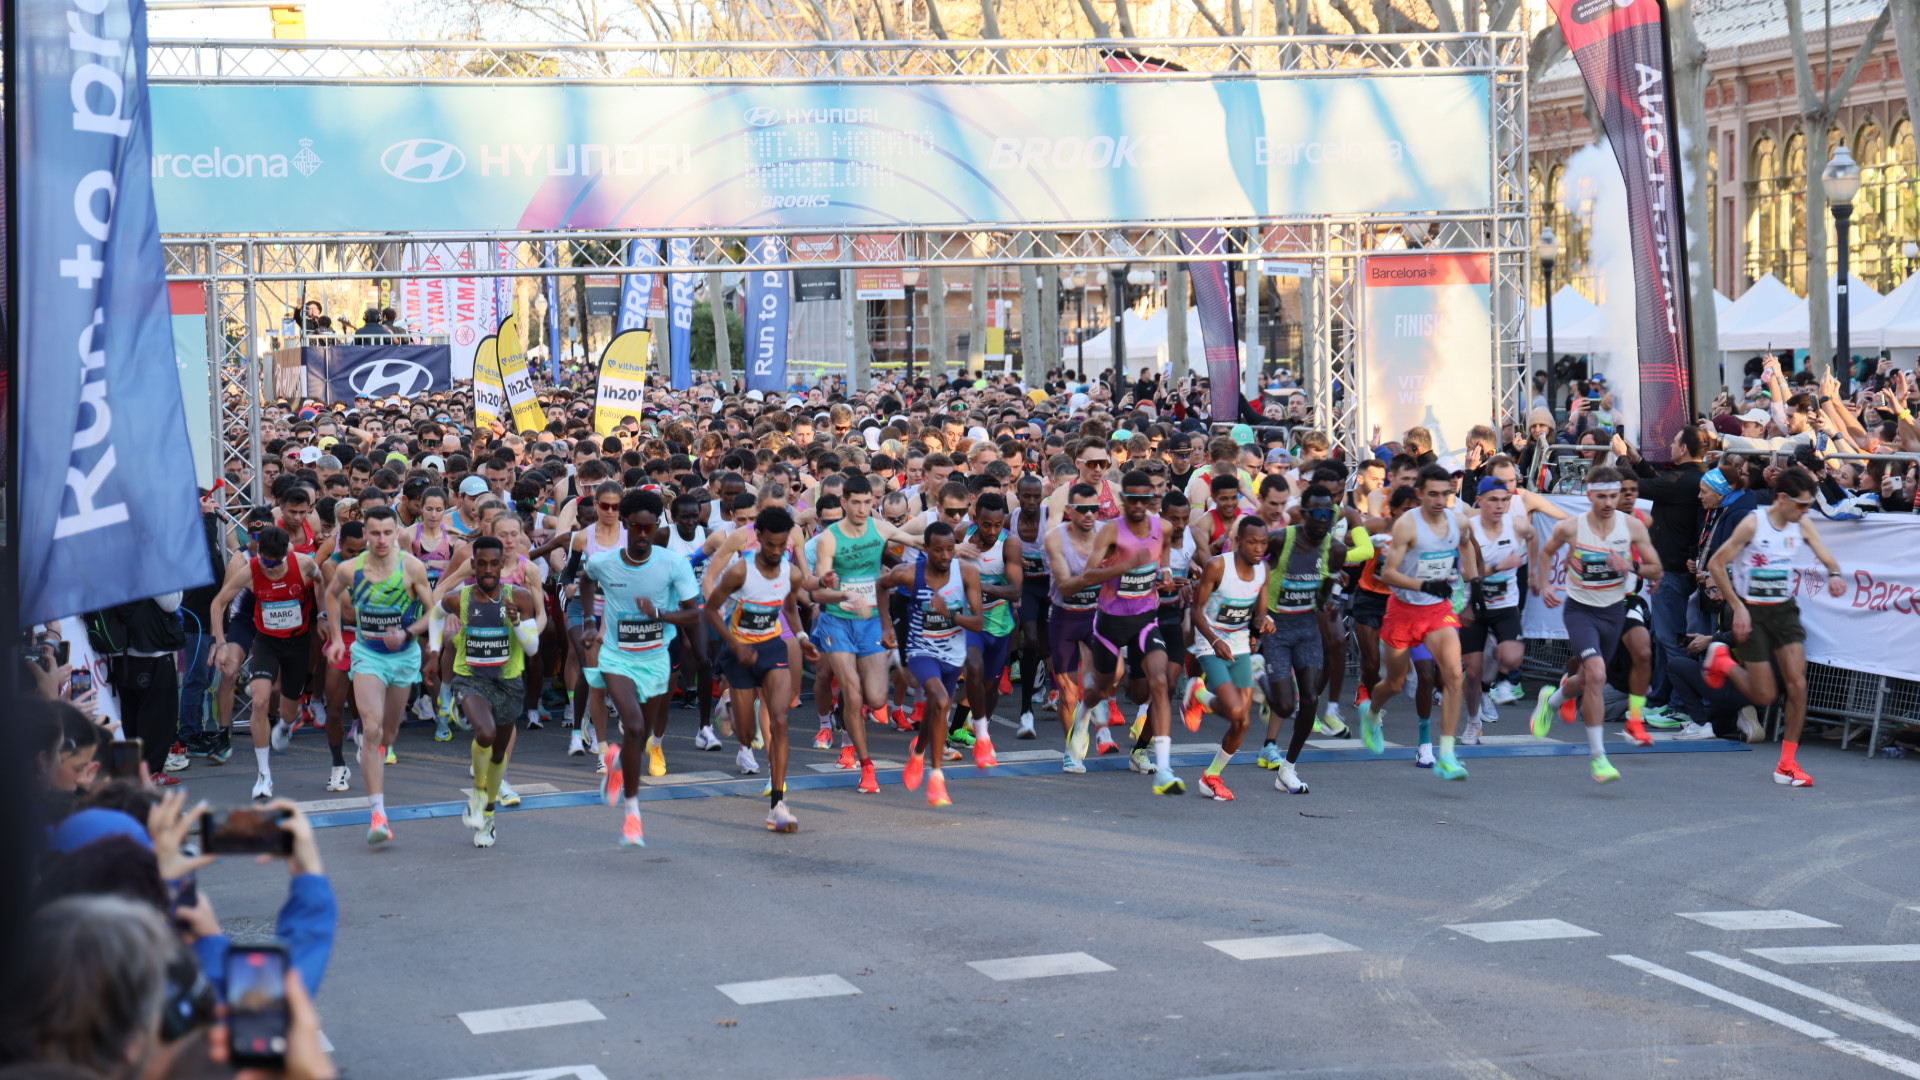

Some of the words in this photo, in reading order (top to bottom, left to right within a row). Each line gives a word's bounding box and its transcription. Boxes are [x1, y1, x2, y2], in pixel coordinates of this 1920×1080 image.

[786, 108, 878, 123] HYUNDAI
[744, 131, 820, 158] MITJA
[832, 124, 935, 157] MARATÓ
[1255, 136, 1402, 165] Barcelona
[152, 147, 288, 178] rcelona
[480, 143, 692, 177] HYUNDAI
[989, 136, 1167, 170] BROOKS
[745, 161, 896, 188] BARCELONA
[761, 195, 830, 208] BROOKS
[1372, 267, 1427, 279] Barcelona
[759, 293, 778, 321] to
[755, 327, 776, 376] Run
[484, 368, 500, 377] vitha
[618, 363, 644, 372] vithas
[270, 610, 293, 619] MARC
[618, 622, 663, 634] MOHAMED
[466, 640, 509, 648] CHIAPPINELLI
